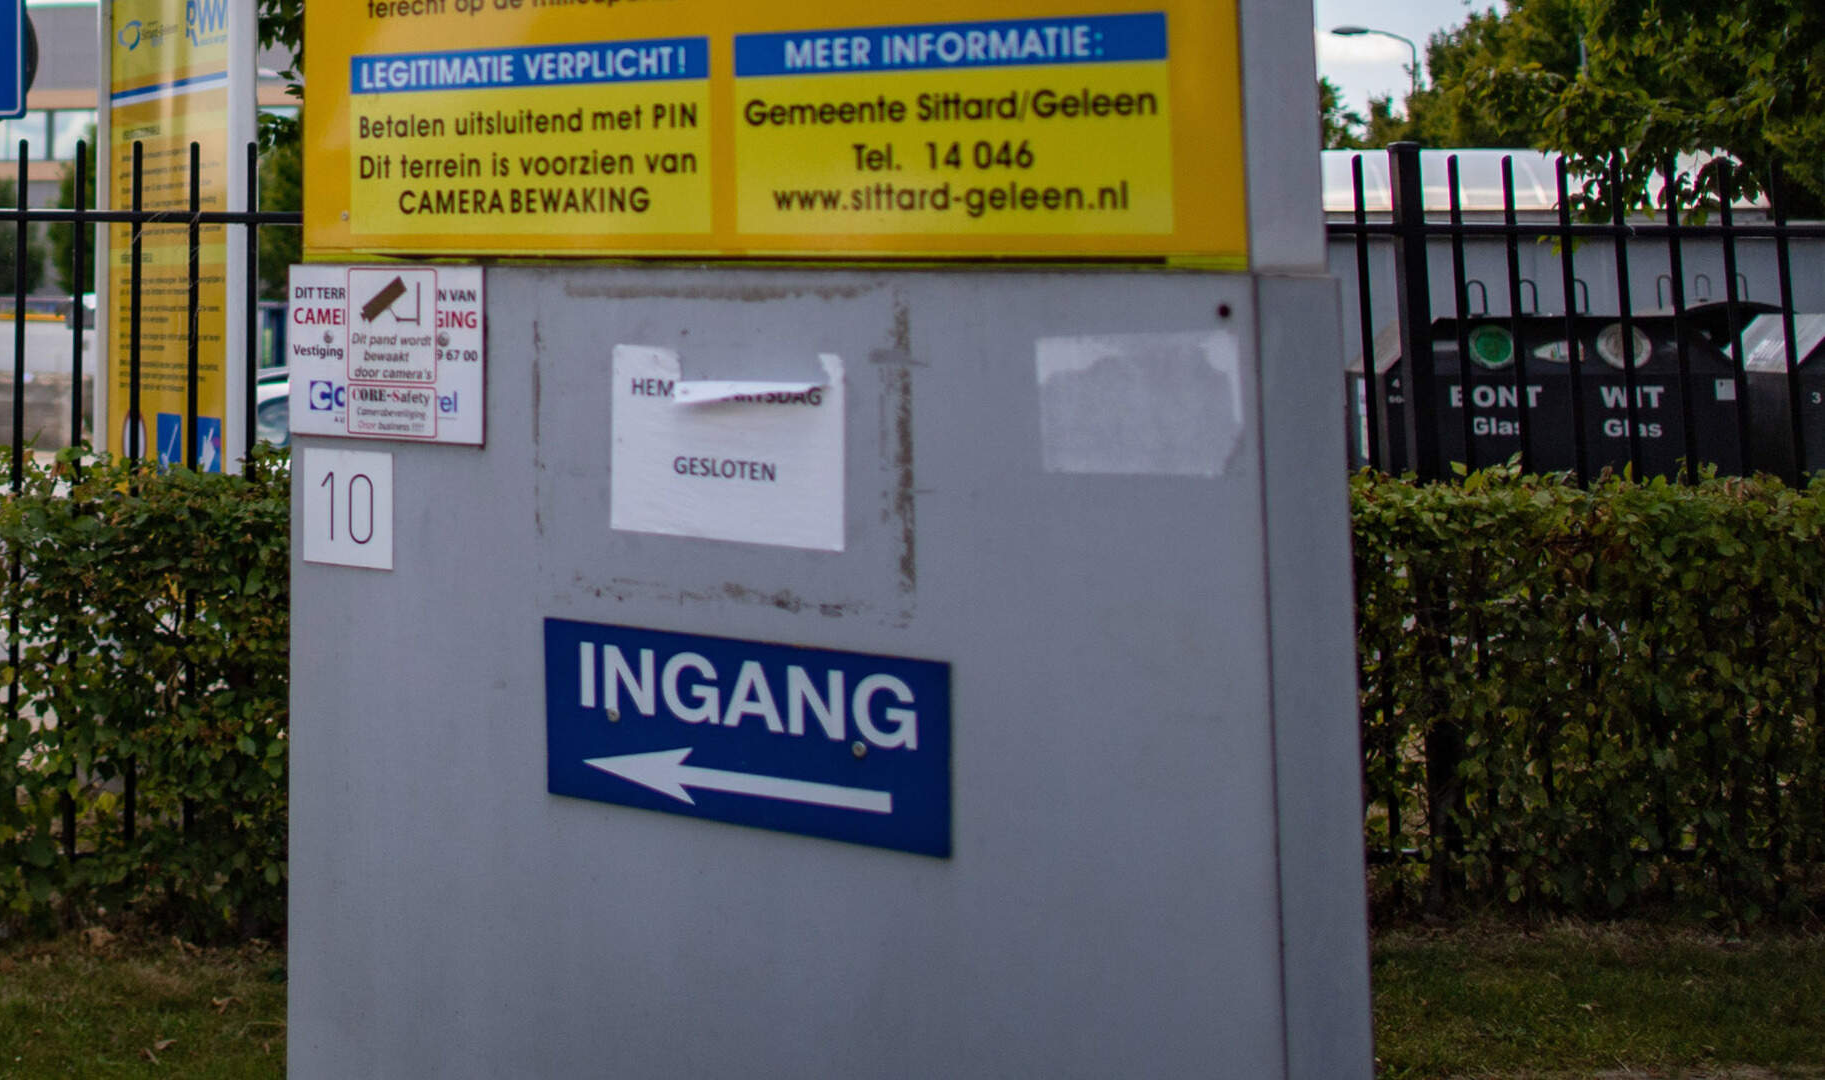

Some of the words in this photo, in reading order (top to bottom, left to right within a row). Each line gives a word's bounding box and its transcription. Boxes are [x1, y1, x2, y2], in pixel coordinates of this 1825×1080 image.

[784, 36, 871, 69] MEER
[882, 25, 1105, 66] INFORMATIE:
[361, 54, 514, 90] LEGITIMATIE
[523, 46, 687, 81] VERPLICHT!
[359, 114, 445, 140] Betalen
[455, 108, 583, 136] uitsluitend
[591, 105, 644, 131] met
[652, 102, 698, 129] PIN
[744, 95, 907, 127] Gemeente
[916, 88, 1158, 123] Sittard/Geleen
[359, 154, 391, 180] Dit
[400, 152, 481, 179] terrein
[491, 152, 510, 177] is
[519, 149, 635, 177] voorzien
[646, 151, 697, 175] van
[853, 142, 902, 171] Tel.
[925, 141, 962, 170] 14
[973, 139, 1035, 171] 046
[774, 180, 1129, 218] www.sittard-geleen.nl
[295, 286, 314, 300] DIT
[450, 289, 477, 303] VAN
[293, 344, 344, 361] Vestiging
[368, 333, 397, 348] pand
[400, 335, 432, 347] wordt
[364, 349, 410, 362] bewaakt
[446, 349, 460, 361] 67
[463, 350, 478, 362] 00
[354, 366, 379, 378] door
[1600, 386, 1664, 408] WIT
[674, 456, 776, 483] GESLOTEN
[321, 471, 374, 545] 10
[580, 641, 918, 751] INGANG
